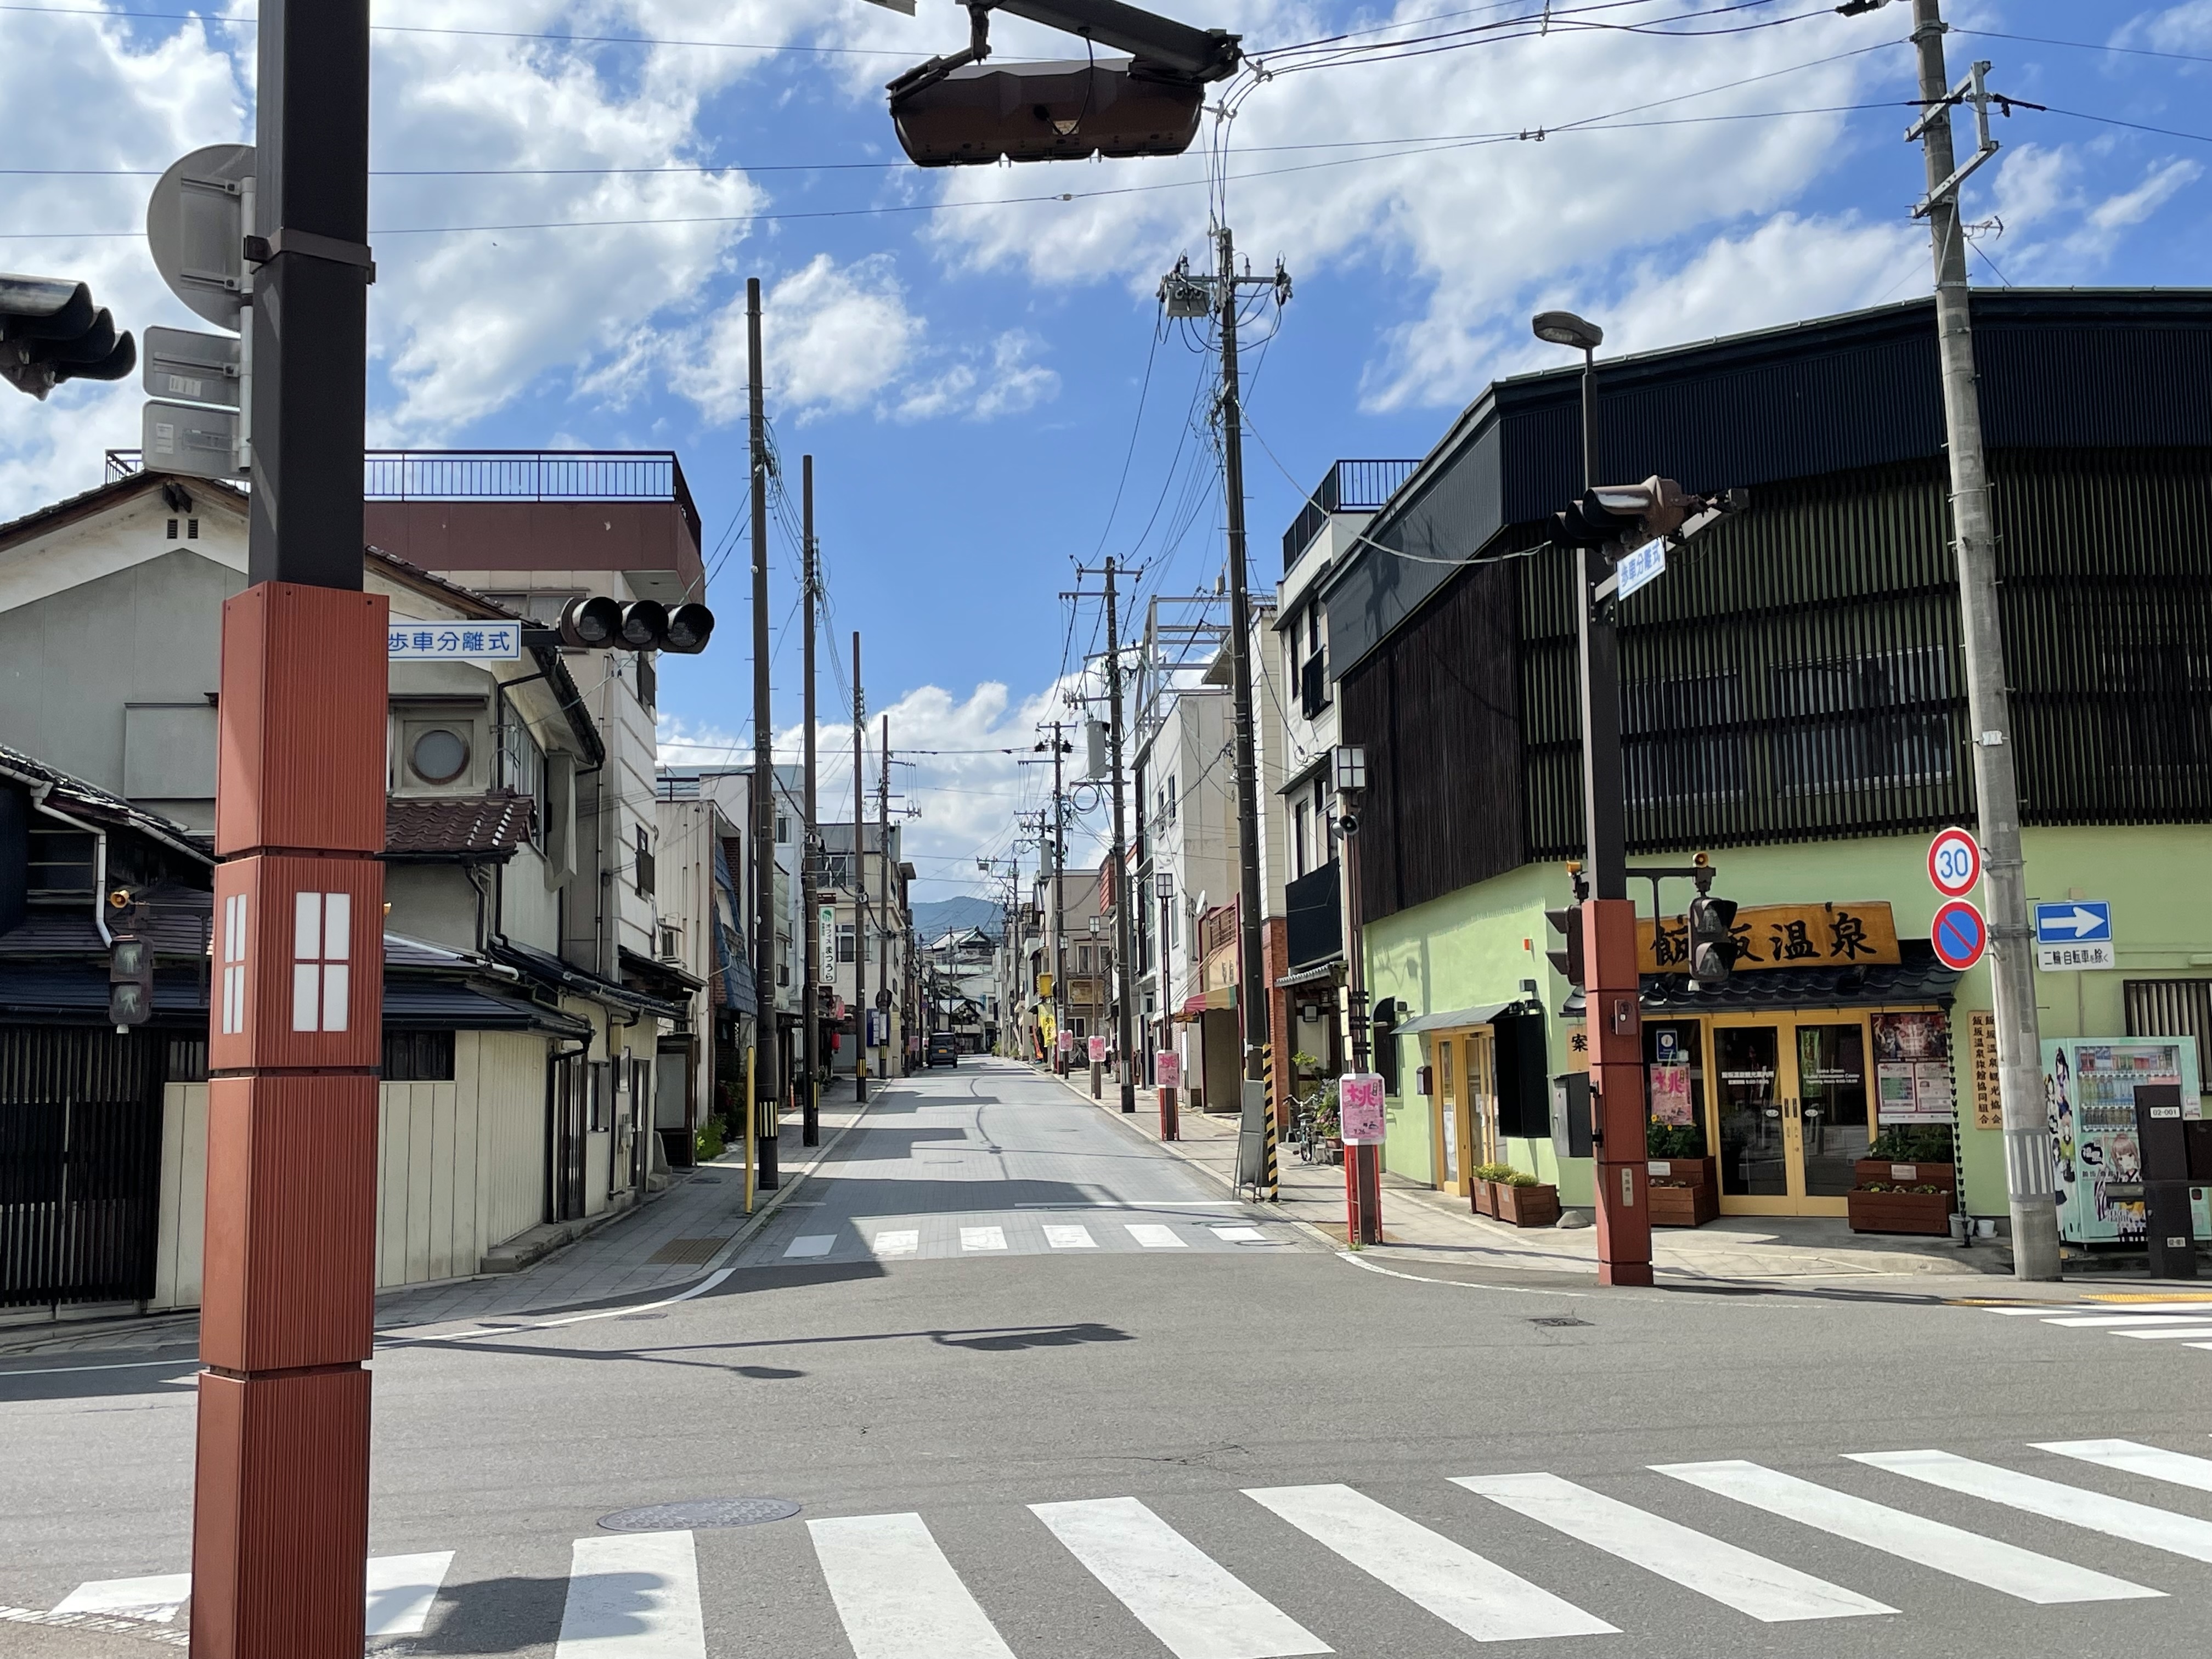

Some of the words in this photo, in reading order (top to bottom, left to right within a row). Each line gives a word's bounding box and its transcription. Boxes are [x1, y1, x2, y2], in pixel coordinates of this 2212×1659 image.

[389, 631, 510, 652] 歩車分離式
[1940, 848, 1968, 879] 30
[1571, 1033, 1588, 1052] 案
[1347, 1084, 1378, 1107] 桃
